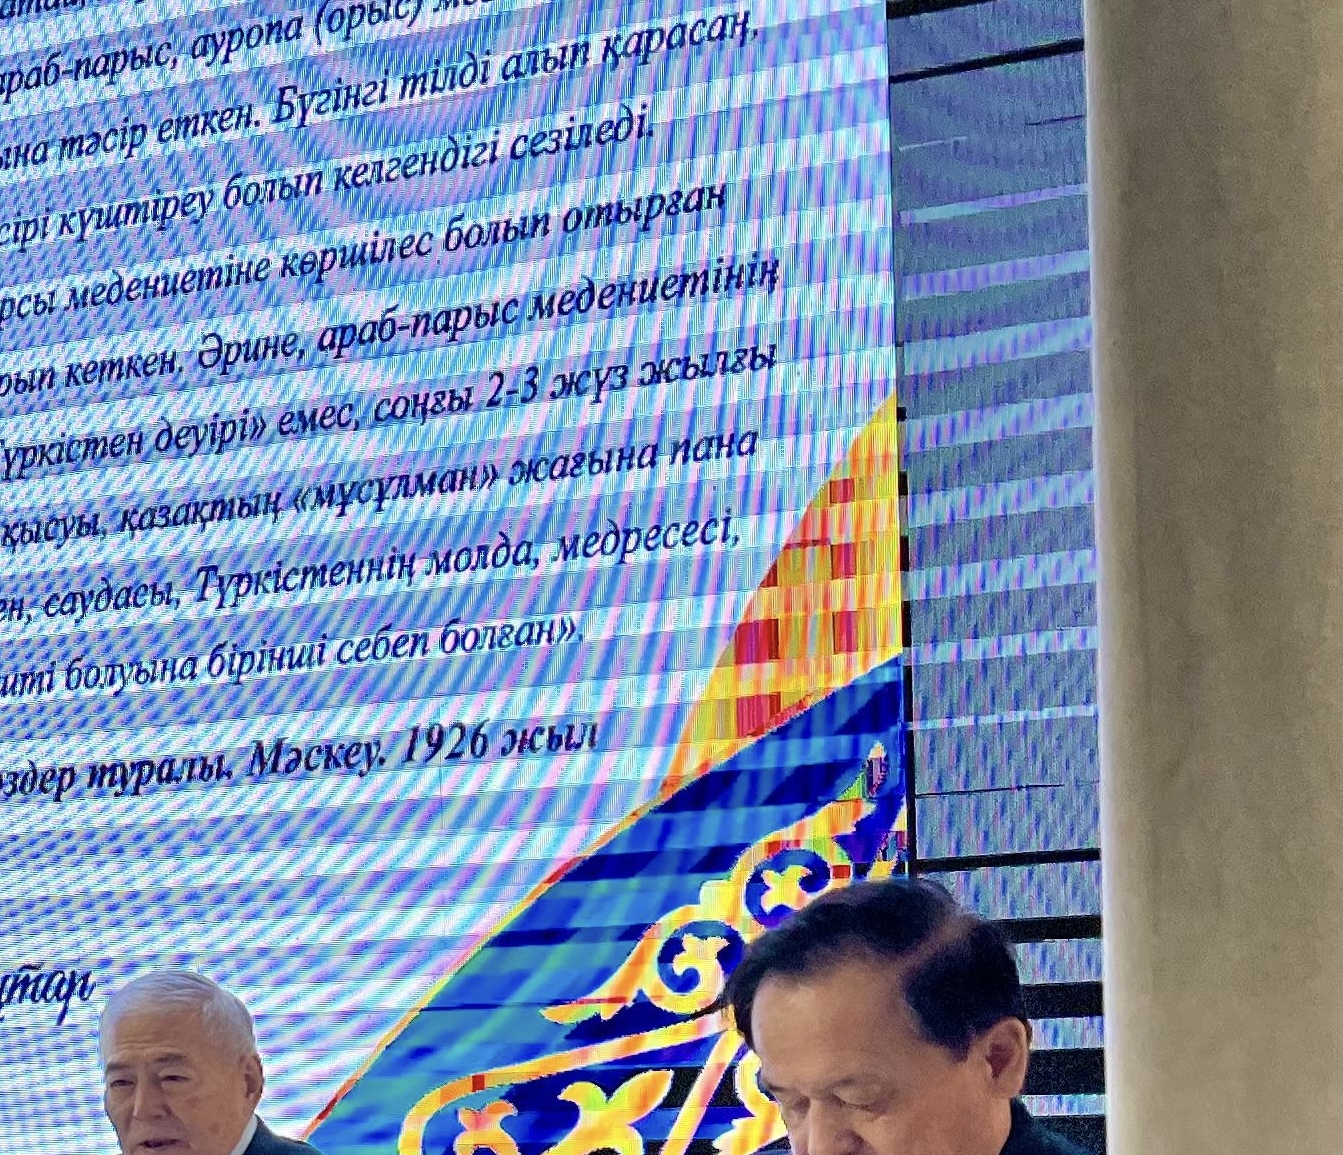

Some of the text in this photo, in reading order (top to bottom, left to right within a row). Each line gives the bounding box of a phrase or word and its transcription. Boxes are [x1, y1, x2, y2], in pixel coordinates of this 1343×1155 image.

[58, 118, 147, 160] тәсір
[158, 106, 261, 144] еткен.
[273, 69, 389, 128] Бүгінгі
[400, 50, 491, 102] тілді
[500, 39, 590, 81] алып
[191, 15, 304, 65] ауропа
[59, 187, 214, 236] күштіреу
[223, 166, 323, 209] болып
[333, 130, 500, 191] келгендігі
[511, 100, 654, 161] сезіледі.
[65, 254, 271, 312] медениетіне
[280, 228, 434, 284] көршілес
[444, 212, 550, 253] болып
[562, 183, 726, 234] отырған
[64, 349, 183, 389] кеткен.
[198, 331, 305, 376] Әрине,
[318, 297, 519, 358] араб-парыс
[527, 251, 780, 323] медениетінің
[155, 411, 267, 458] деуірі»
[278, 401, 359, 437] емес,
[374, 383, 474, 424] соңғы
[485, 366, 539, 409] 2-3
[549, 361, 627, 404] жүз
[638, 340, 777, 387] жылғы
[1, 511, 107, 554] қысуы,
[120, 487, 284, 533] қазақтың
[509, 439, 658, 486] жағына
[669, 429, 759, 467] пана
[44, 575, 180, 622] саудасы,
[196, 546, 417, 611] Түркістеннің
[425, 531, 539, 578] молда,
[550, 507, 740, 563] медресесі,
[63, 654, 198, 692] болуына
[208, 633, 327, 687] бірінші
[336, 622, 430, 662] себеп
[406, 718, 489, 763] 1926
[501, 720, 599, 757] жыл
